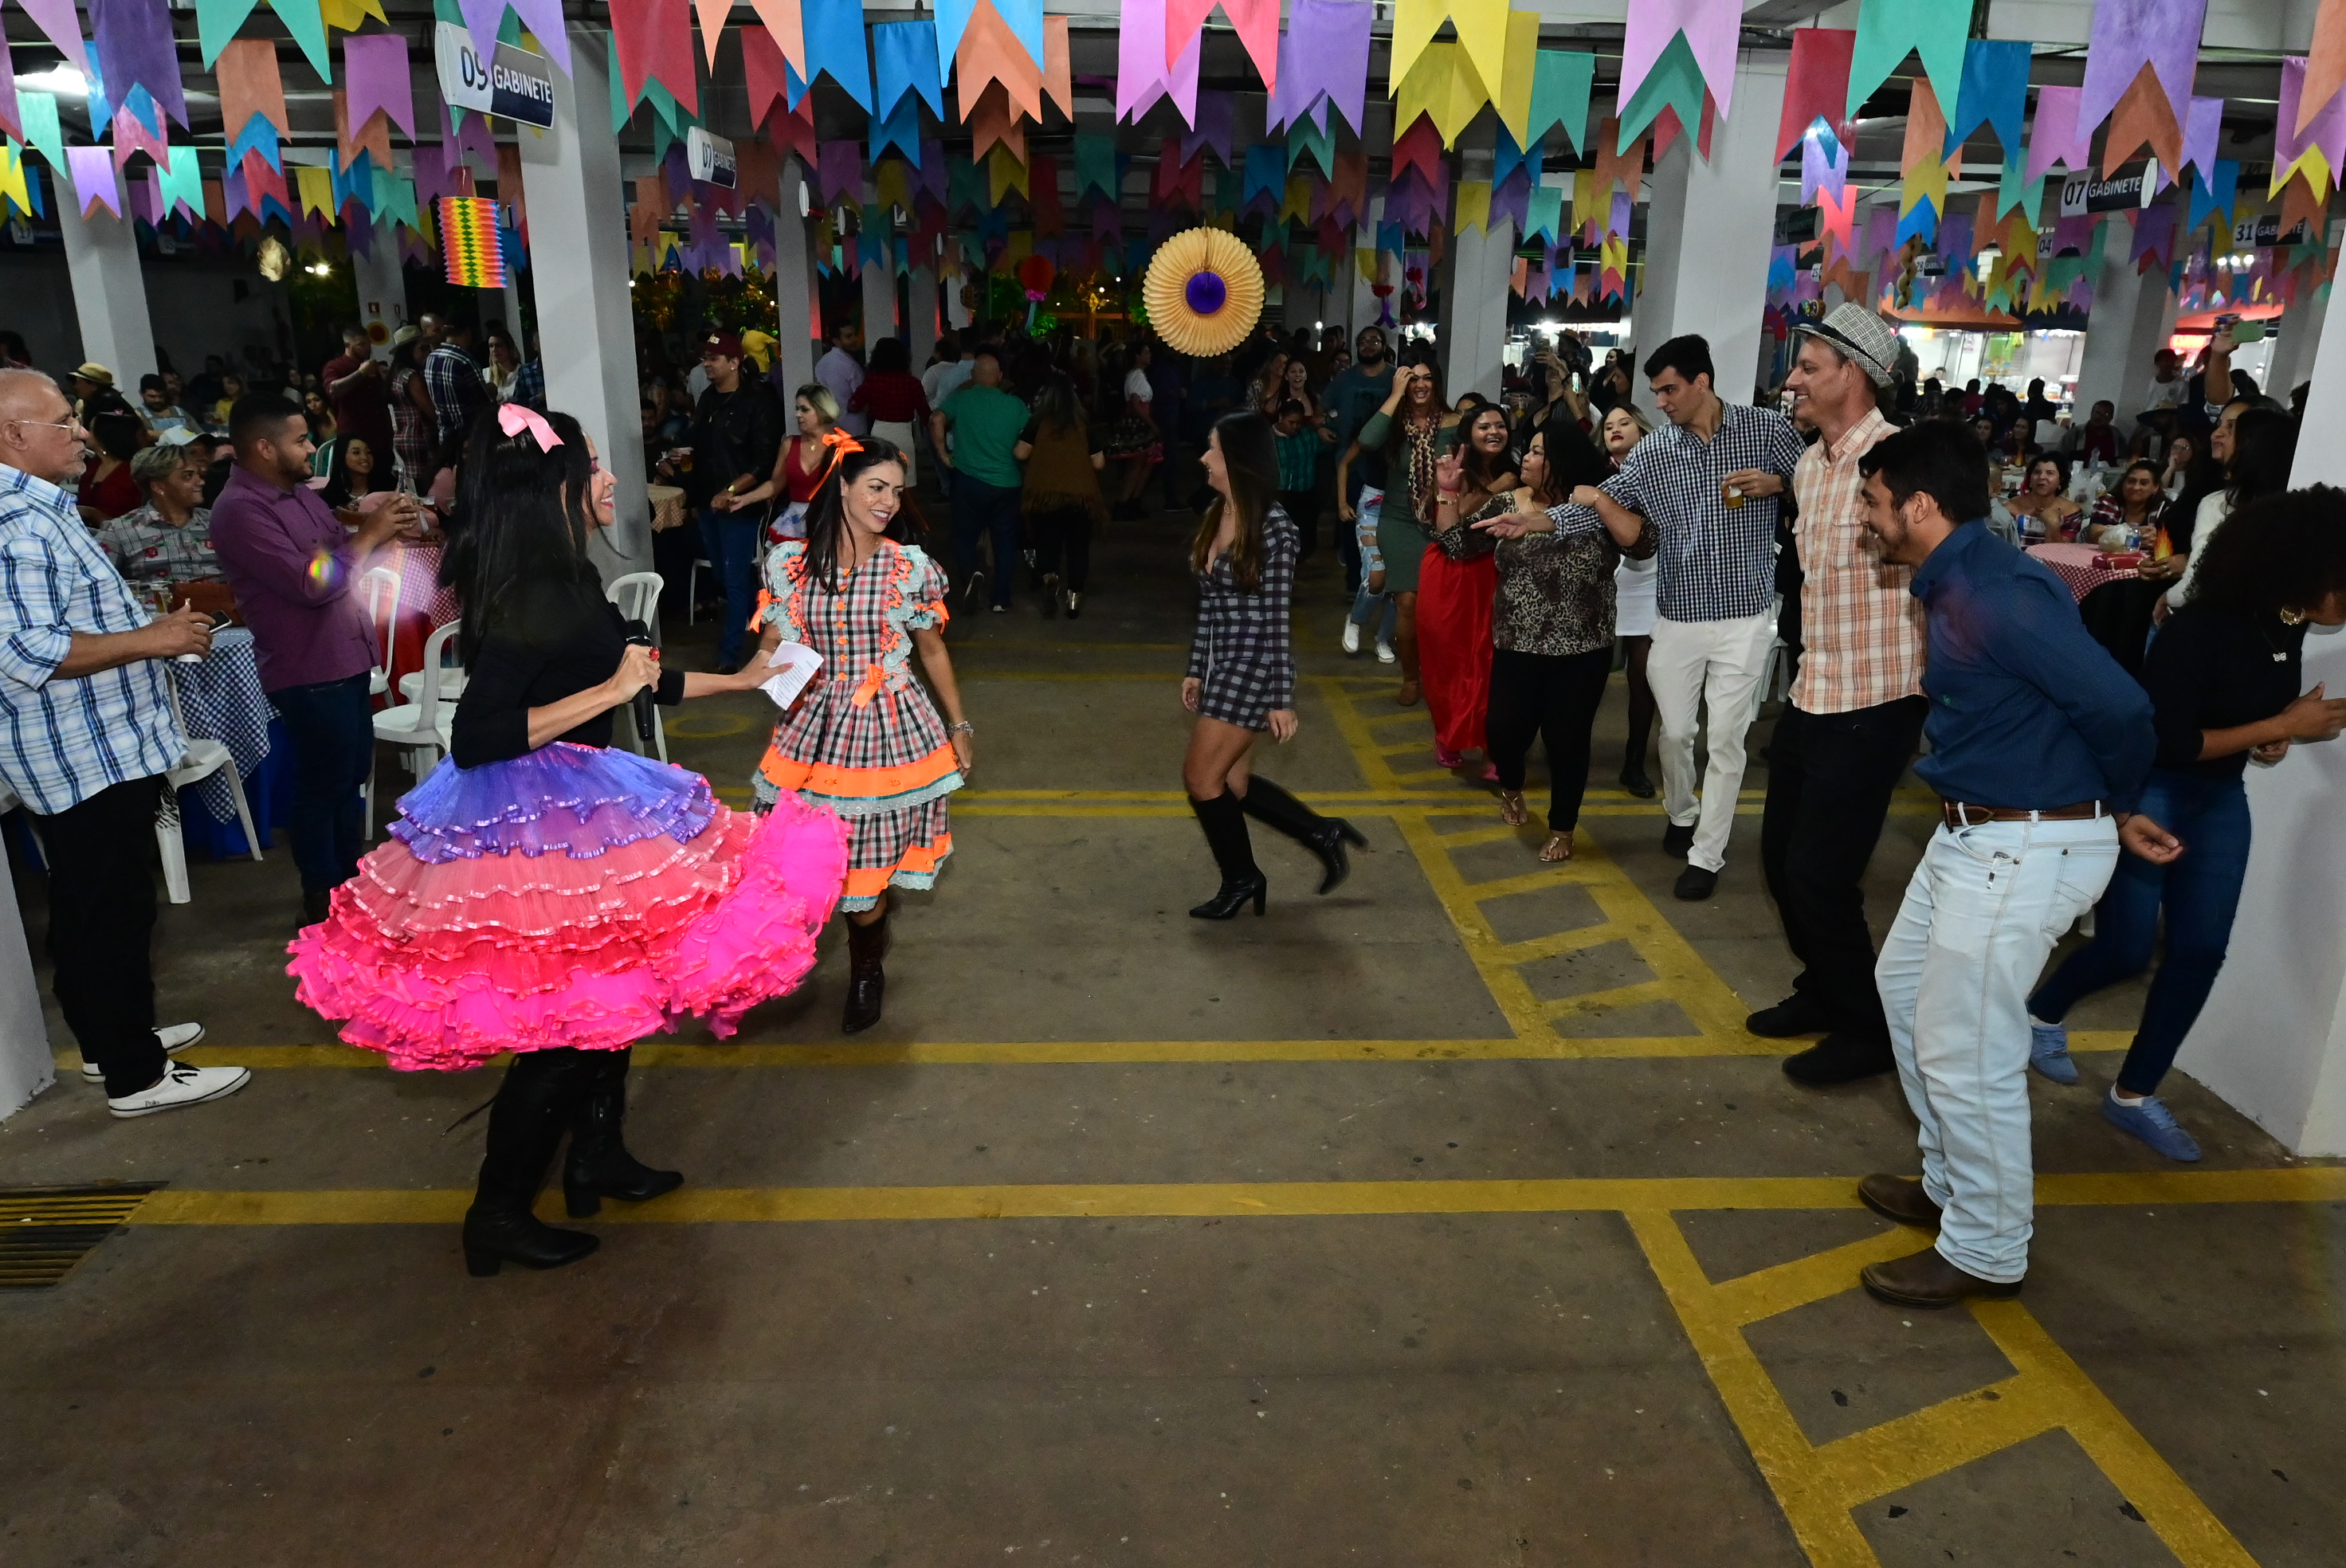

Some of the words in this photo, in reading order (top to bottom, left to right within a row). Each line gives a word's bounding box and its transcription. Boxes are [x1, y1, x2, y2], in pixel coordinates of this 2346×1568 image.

[460, 45, 488, 91] 09
[492, 64, 552, 104] GABINETE
[702, 141, 712, 169] 07
[2065, 181, 2087, 206] 07
[2088, 176, 2143, 198] GABINETE
[2038, 238, 2053, 253] 04
[2235, 223, 2254, 241] 31
[2257, 222, 2304, 237] GABTE
